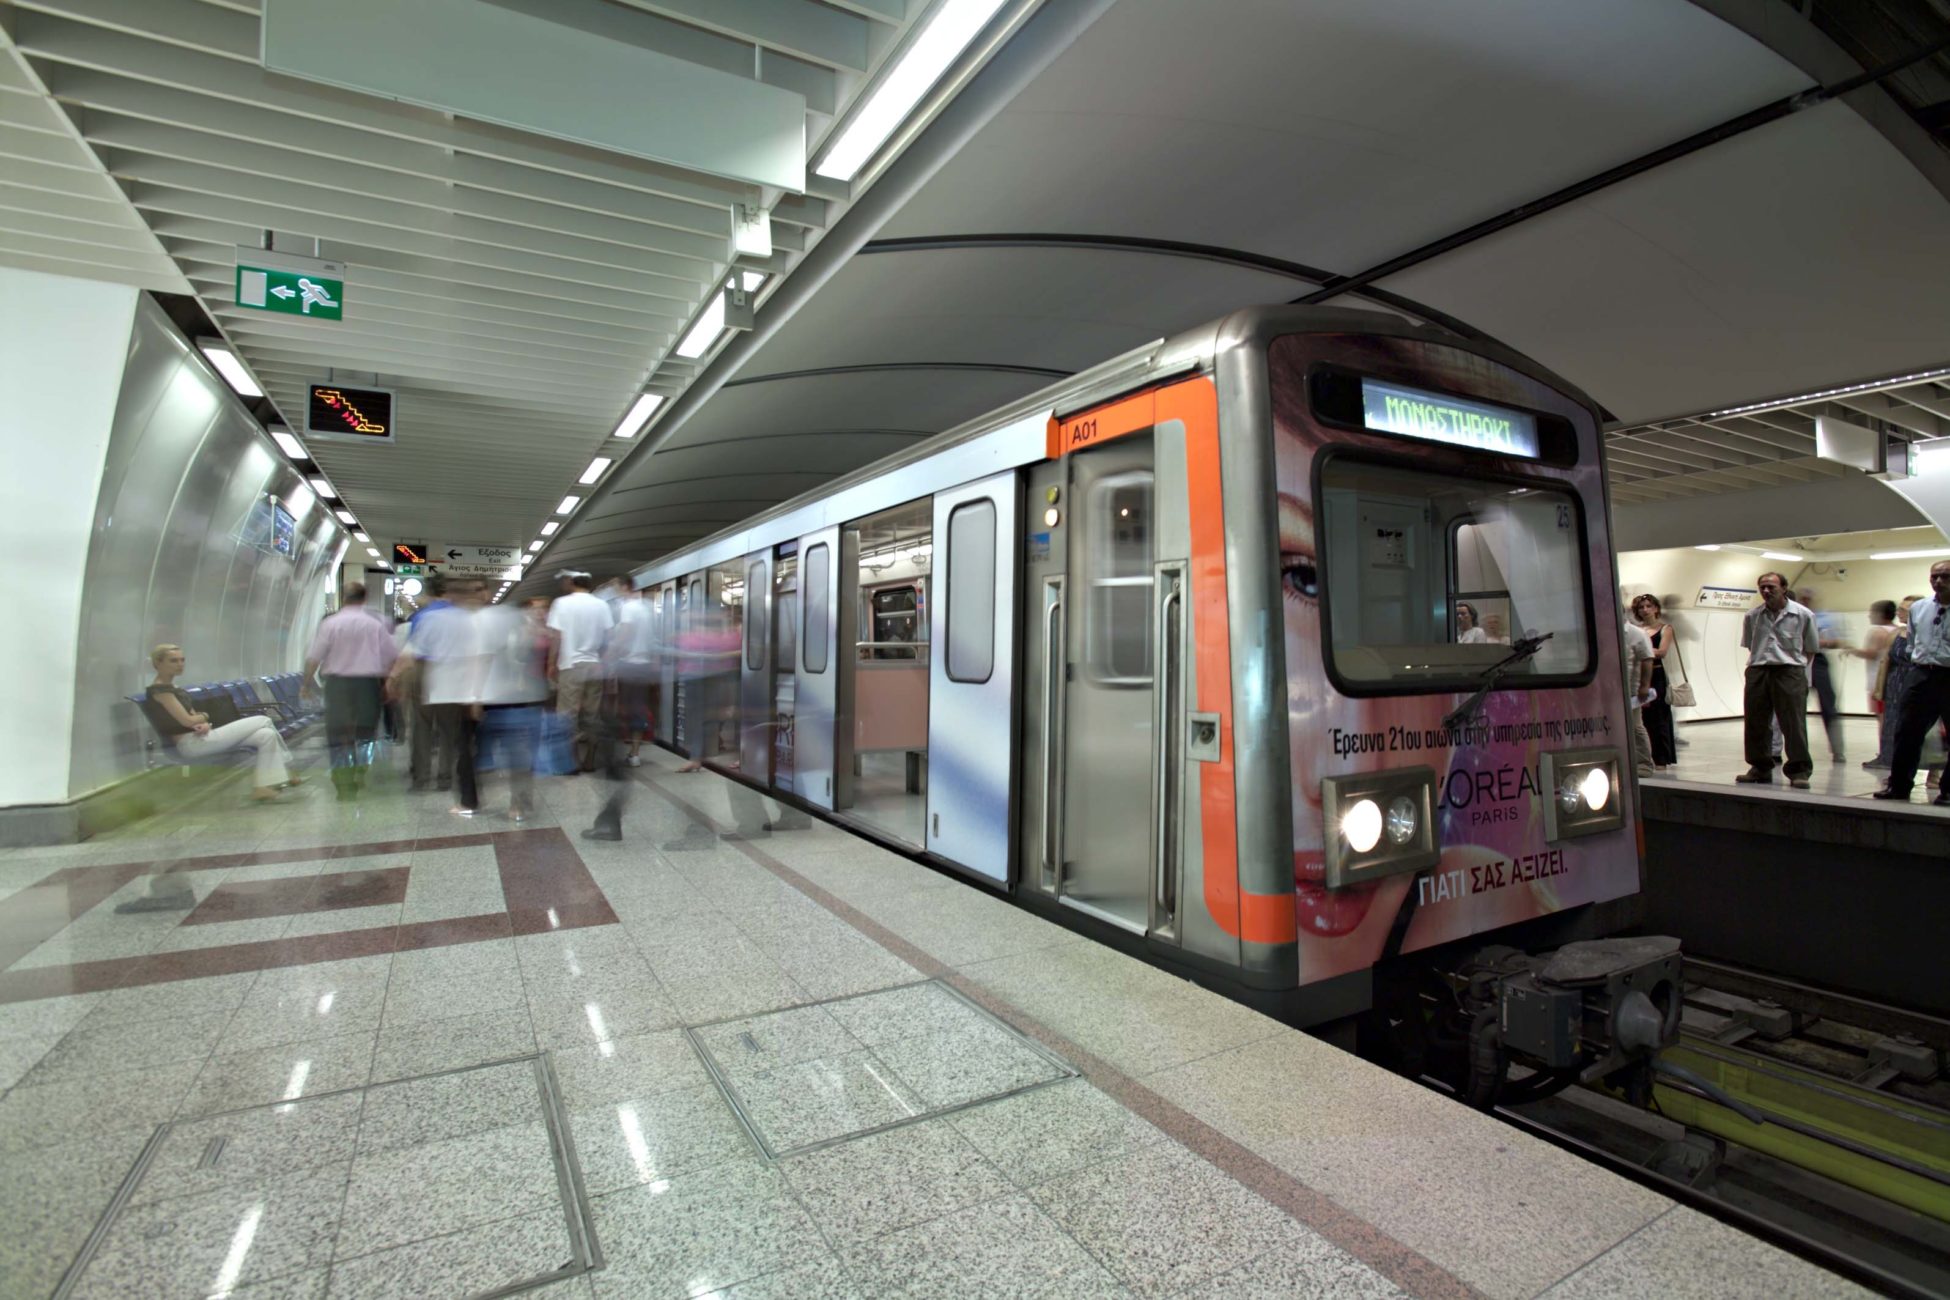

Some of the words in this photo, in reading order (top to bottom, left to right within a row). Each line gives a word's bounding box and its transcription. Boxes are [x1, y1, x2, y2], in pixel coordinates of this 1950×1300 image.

[1072, 418, 1098, 444] A01
[1385, 396, 1512, 446] ΜΟΝΑΣΤΗΡΑΚΙ
[1328, 728, 1385, 760] Έρευνα
[1389, 725, 1421, 751] 21ου
[1493, 718, 1542, 747] υπηρεσία
[1544, 720, 1563, 742] της
[1418, 868, 1466, 906] ΓΙΑΤΙ
[1471, 861, 1506, 894] ΣΑΣ
[1511, 848, 1568, 885] ΑΞΙΖΕΙ.
